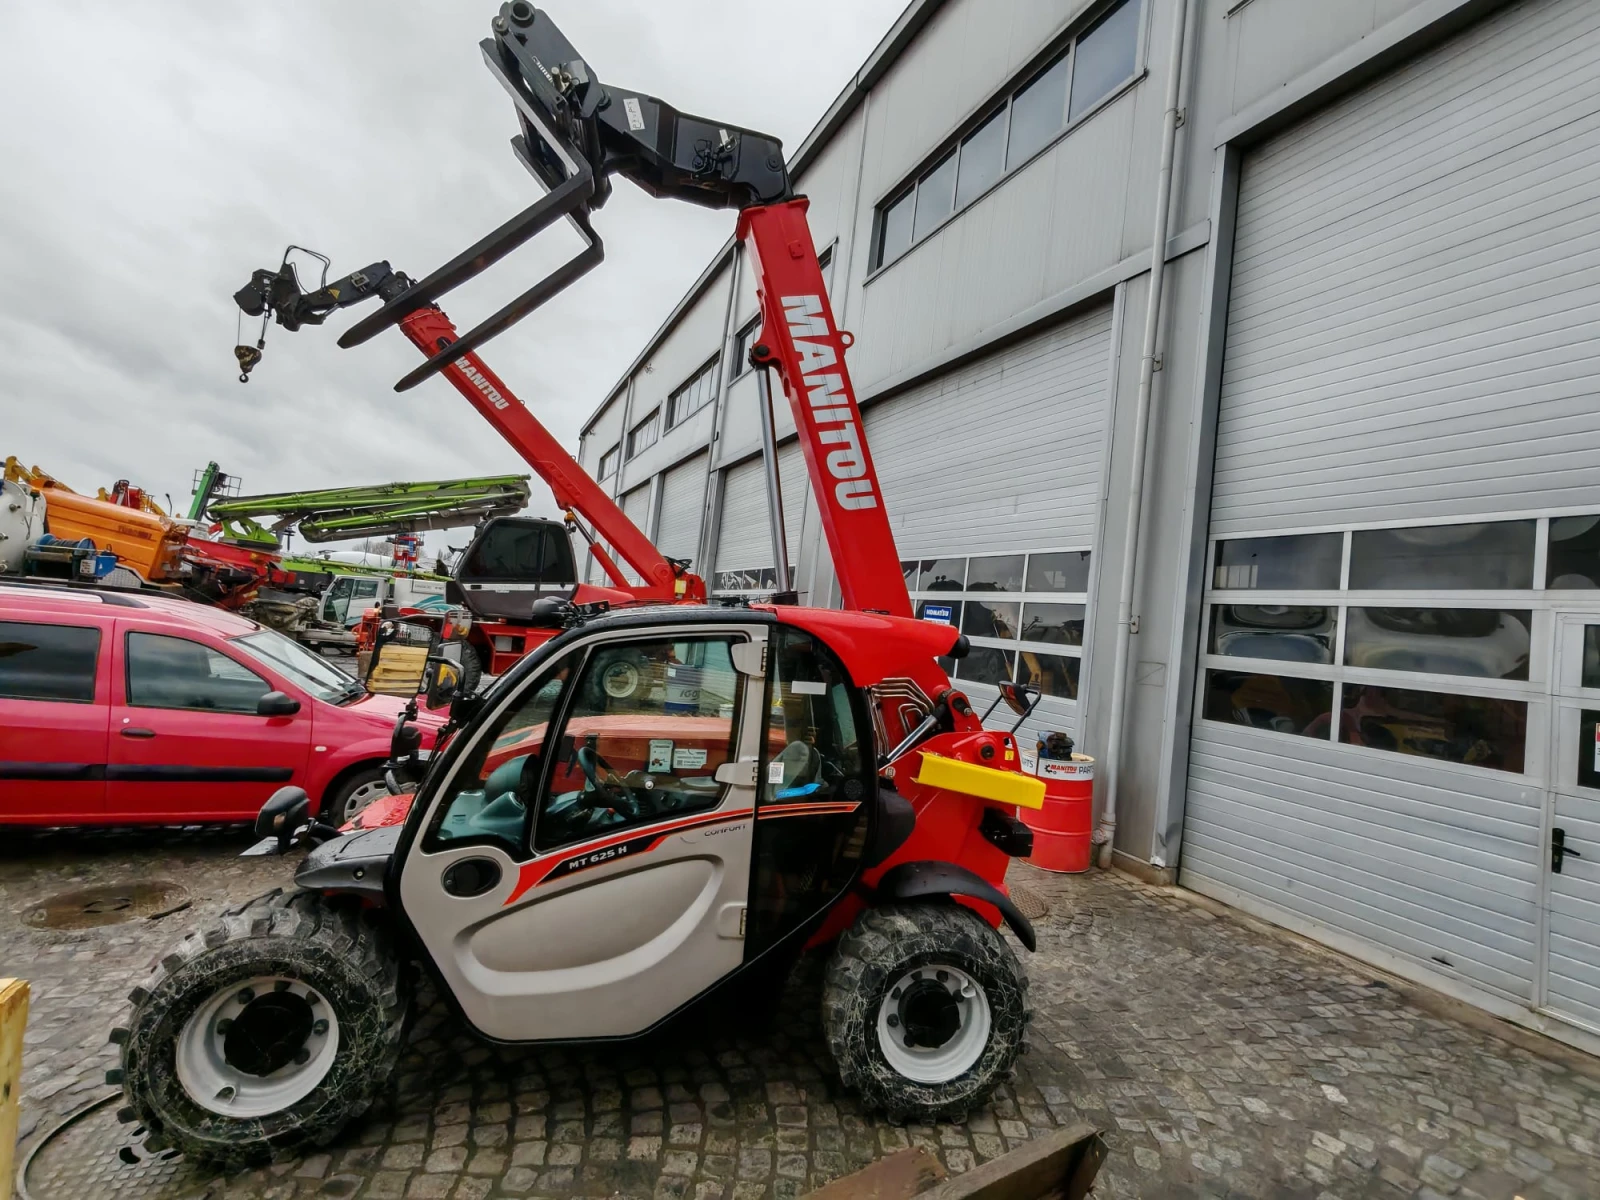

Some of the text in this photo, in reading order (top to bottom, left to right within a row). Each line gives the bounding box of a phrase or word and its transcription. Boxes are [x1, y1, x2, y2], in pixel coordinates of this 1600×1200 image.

[454, 355, 510, 410] MANITOU
[780, 294, 878, 511] MANITOU
[926, 608, 950, 617] KOMATSU
[1050, 764, 1078, 772] MANITOU
[569, 845, 627, 869] MT 625 H
